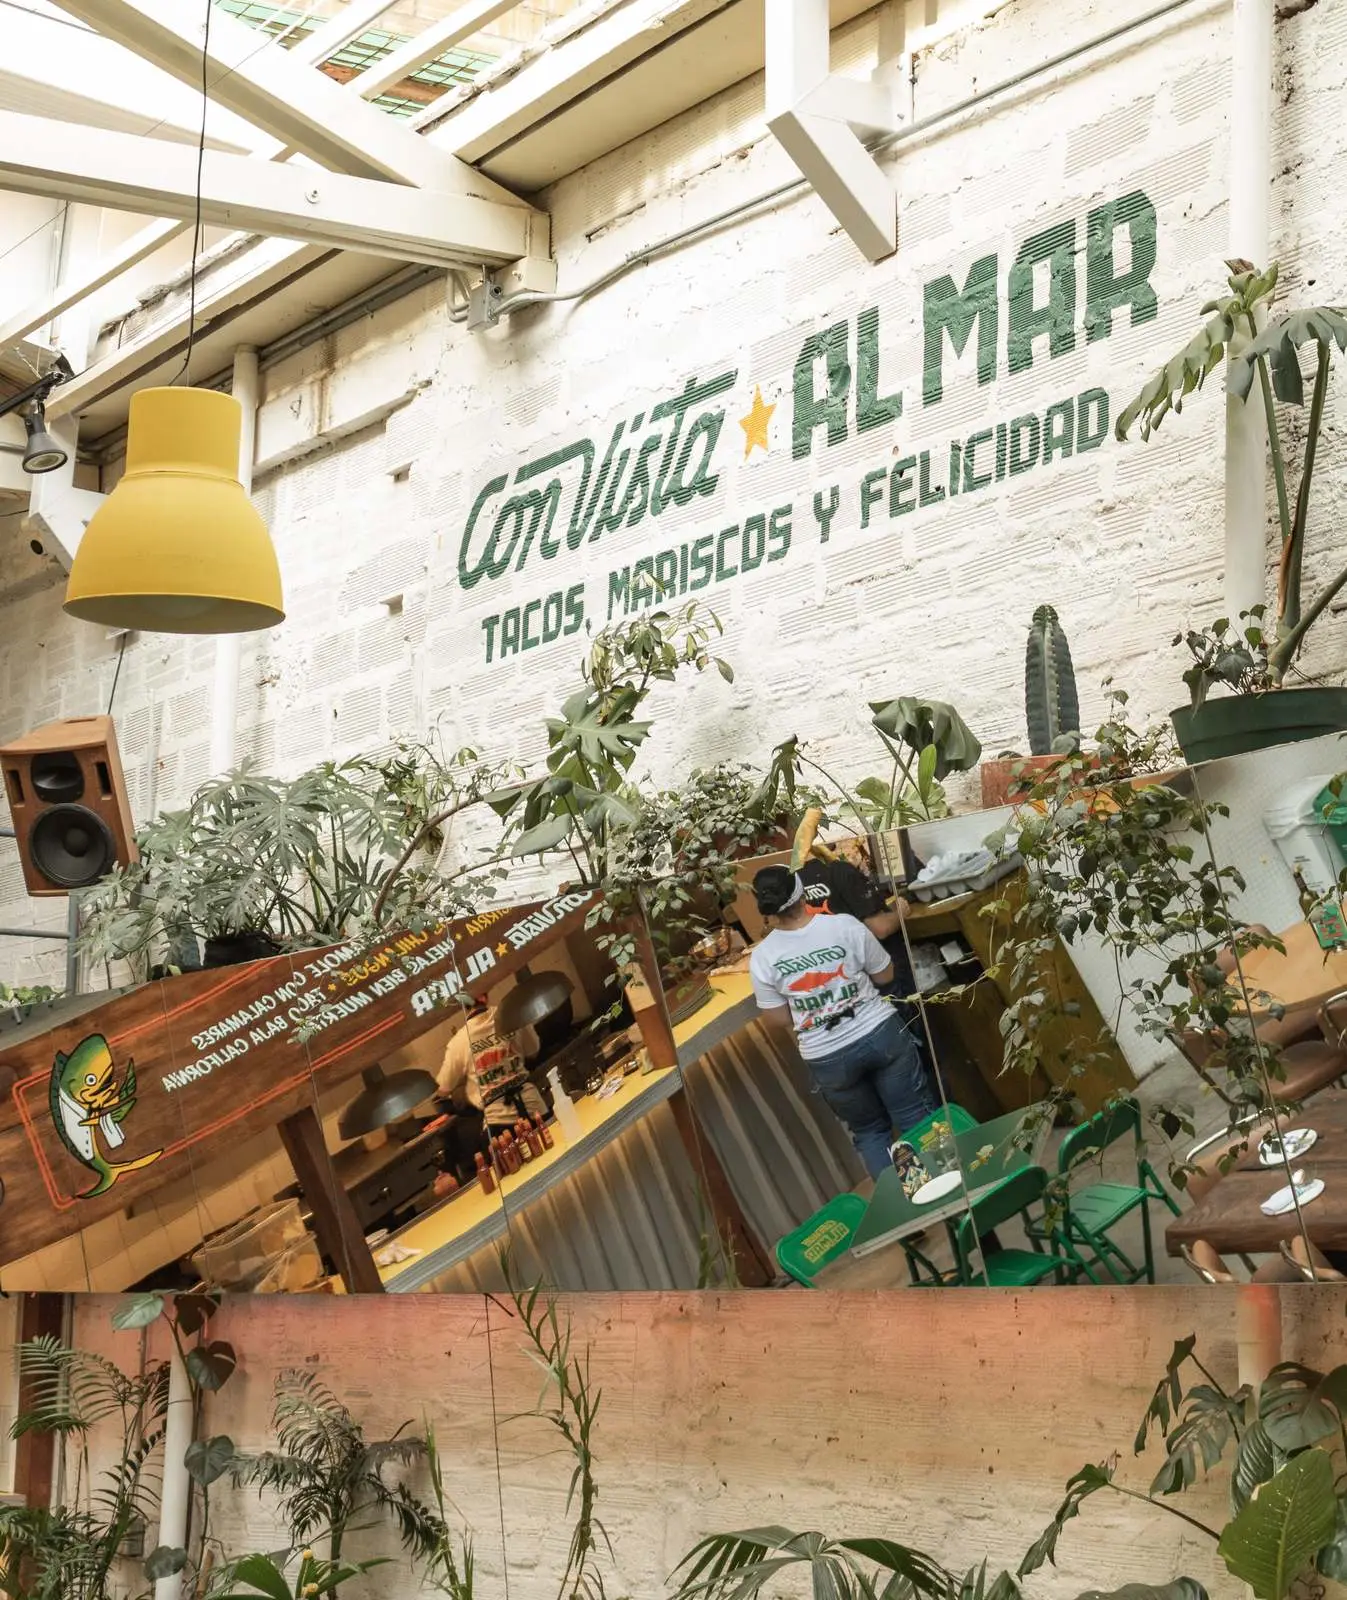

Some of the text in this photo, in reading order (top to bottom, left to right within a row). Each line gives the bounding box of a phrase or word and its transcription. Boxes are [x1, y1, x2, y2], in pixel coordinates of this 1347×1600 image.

[792, 305, 903, 460] AL
[922, 189, 1158, 409] MAR
[607, 503, 793, 621] MARISCOS
[813, 485, 839, 543] Y
[860, 386, 1110, 529] FELICIDAD
